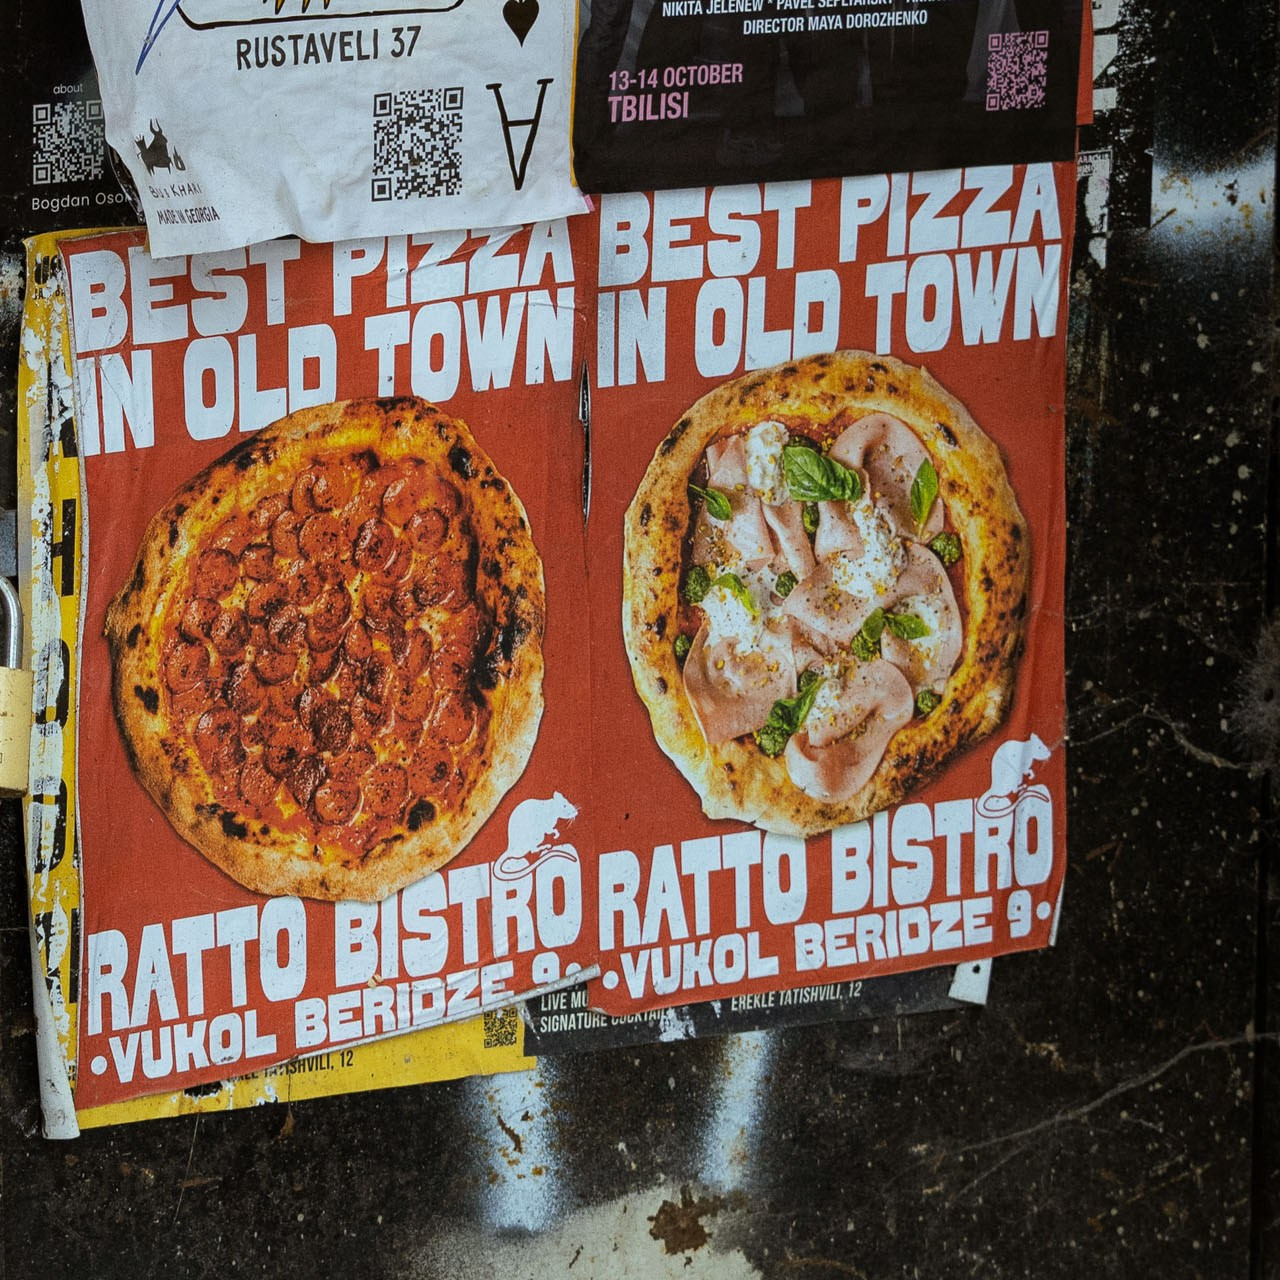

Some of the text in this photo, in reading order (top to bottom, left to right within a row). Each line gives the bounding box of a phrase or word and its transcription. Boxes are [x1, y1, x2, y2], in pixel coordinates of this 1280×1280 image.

[662, 0, 703, 18] NIKITA
[742, 9, 928, 36] DIRECTOR MAYA DOROZHENKO
[236, 26, 422, 71] RUSTAVELI 37
[53, 84, 84, 96] about
[608, 62, 744, 91] 13-14 OCTOBER
[607, 91, 690, 124] TBILISI
[32, 195, 90, 213] Bogdan
[185, 205, 220, 225] GEORGIA
[597, 162, 1062, 288] BEST PIZZA
[69, 239, 301, 351] BEST
[333, 216, 576, 318] PIZZA
[597, 244, 1062, 389] IN OLD TOWN
[76, 286, 576, 457] IN OLD TOWN
[598, 784, 1053, 952] RATTO BISTRO
[87, 843, 583, 1037] RATTO BISTRO
[619, 889, 1032, 999] VUKOL BERIDZE 9
[541, 992, 567, 1011] LIVE
[731, 992, 776, 1012] EREKLE
[848, 980, 863, 998] 12
[109, 951, 558, 1084] VUKOL BERIDZE 9
[540, 1010, 608, 1033] SIGNATURE
[340, 1050, 354, 1067] 12
